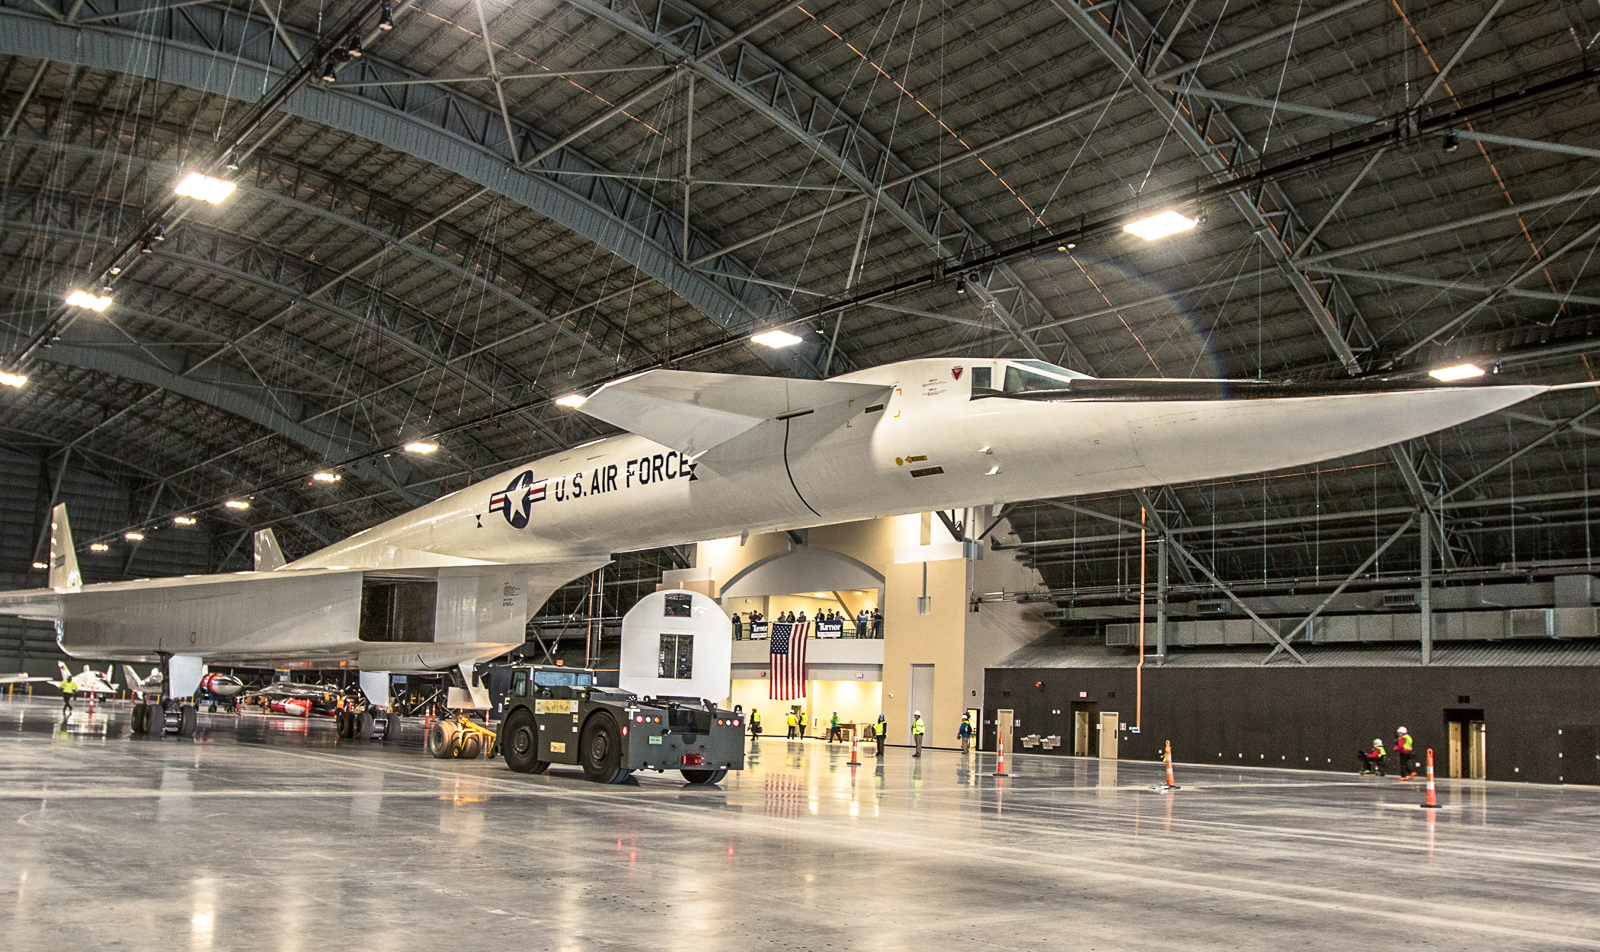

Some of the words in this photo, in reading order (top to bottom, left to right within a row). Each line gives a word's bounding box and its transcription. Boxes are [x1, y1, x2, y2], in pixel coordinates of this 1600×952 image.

[555, 472, 587, 502] U.S.
[591, 464, 618, 495] AIR
[626, 451, 691, 488] FORCE
[818, 623, 841, 631] Turner
